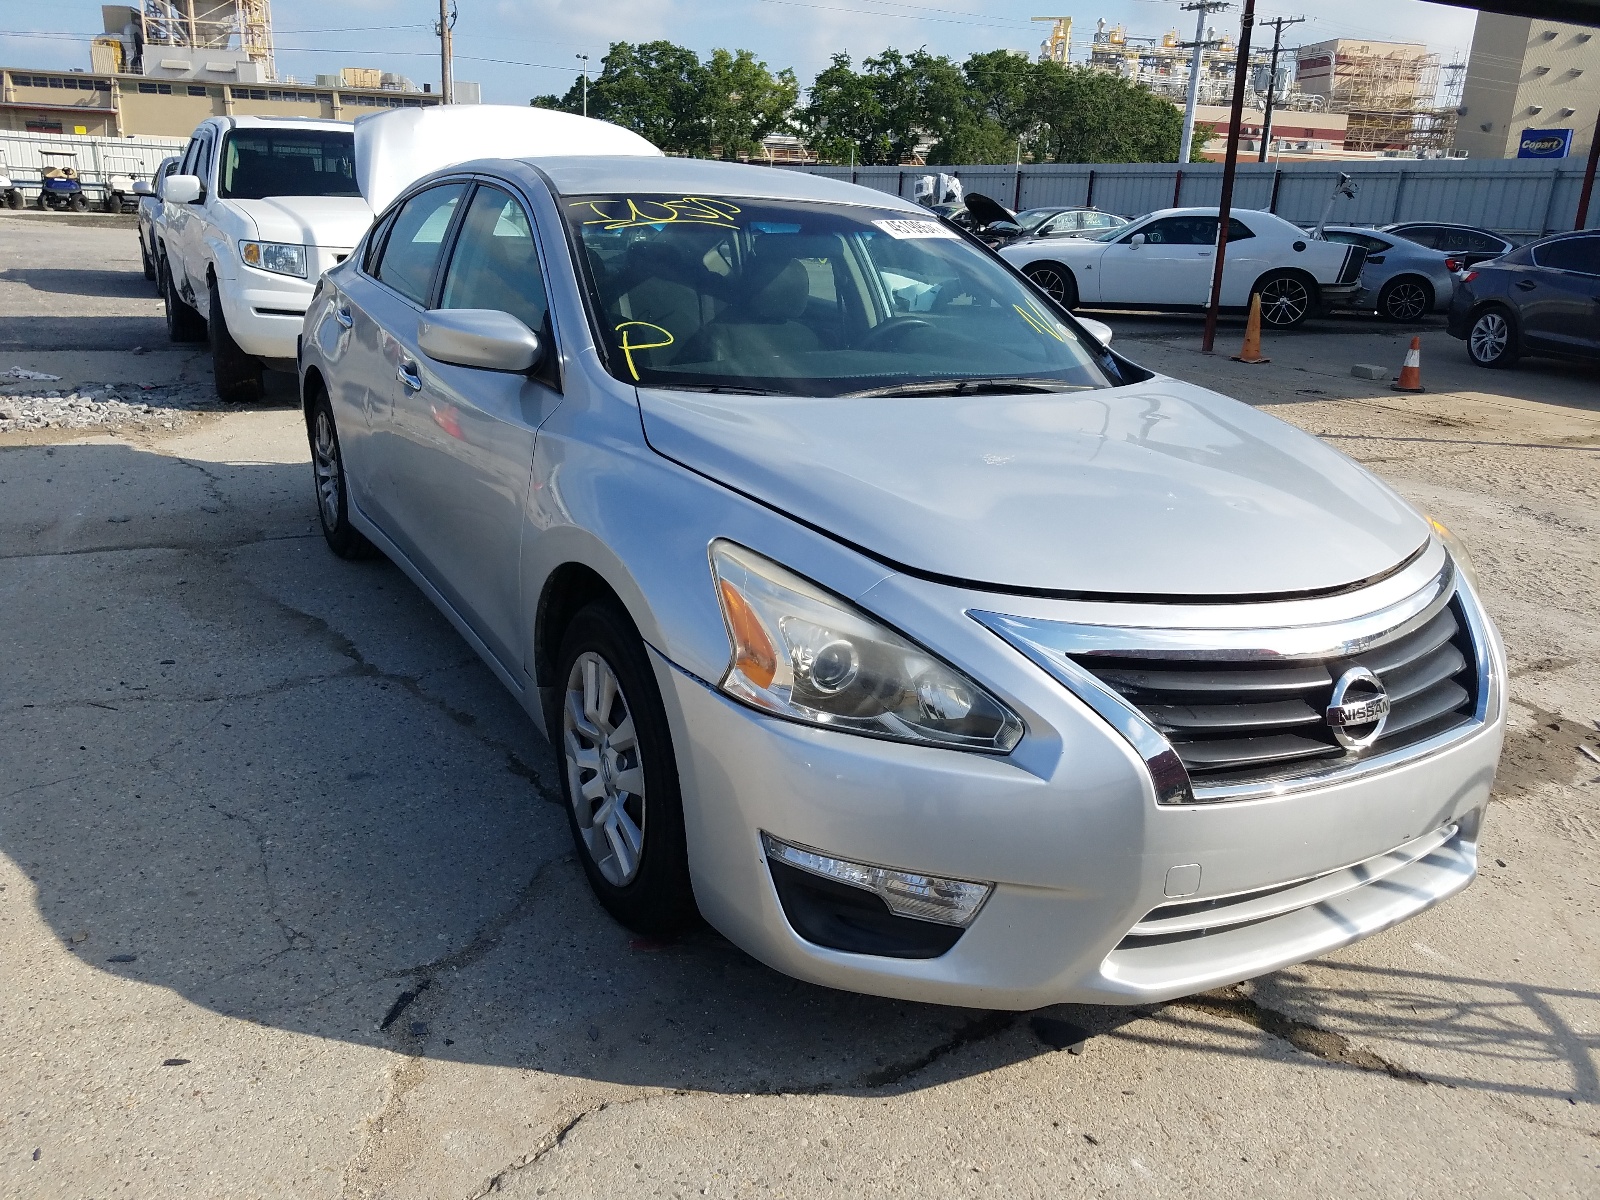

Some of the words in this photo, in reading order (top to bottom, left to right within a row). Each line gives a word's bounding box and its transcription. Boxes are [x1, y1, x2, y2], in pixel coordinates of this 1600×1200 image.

[1522, 139, 1558, 150] Copart
[615, 321, 674, 380] P
[1338, 700, 1389, 723] NISSAN
